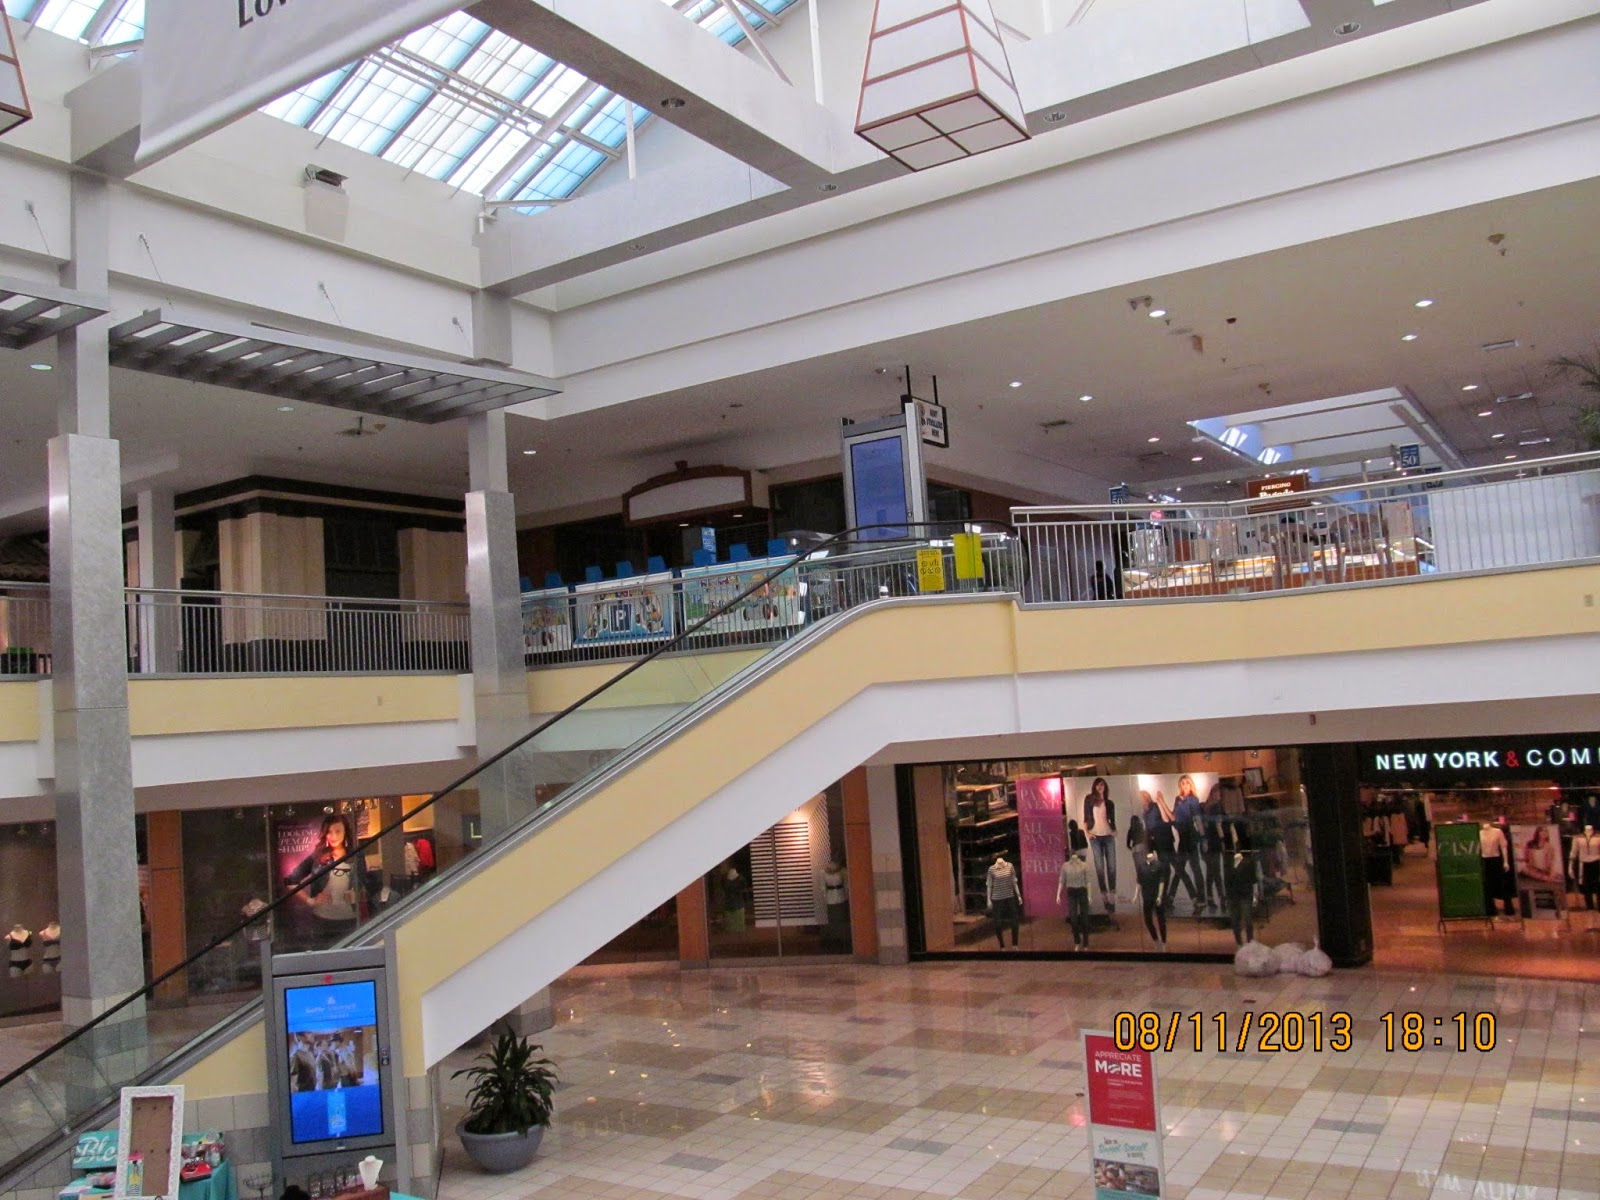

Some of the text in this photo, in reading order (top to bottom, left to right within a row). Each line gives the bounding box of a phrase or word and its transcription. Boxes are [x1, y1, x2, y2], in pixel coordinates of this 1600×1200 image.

[1261, 482, 1291, 491] PIERCING
[1376, 747, 1600, 770] NEW YORK & COM
[1024, 822, 1043, 834] ALL
[1023, 834, 1061, 845] PANTS
[1095, 1051, 1142, 1062] APPRECIATE
